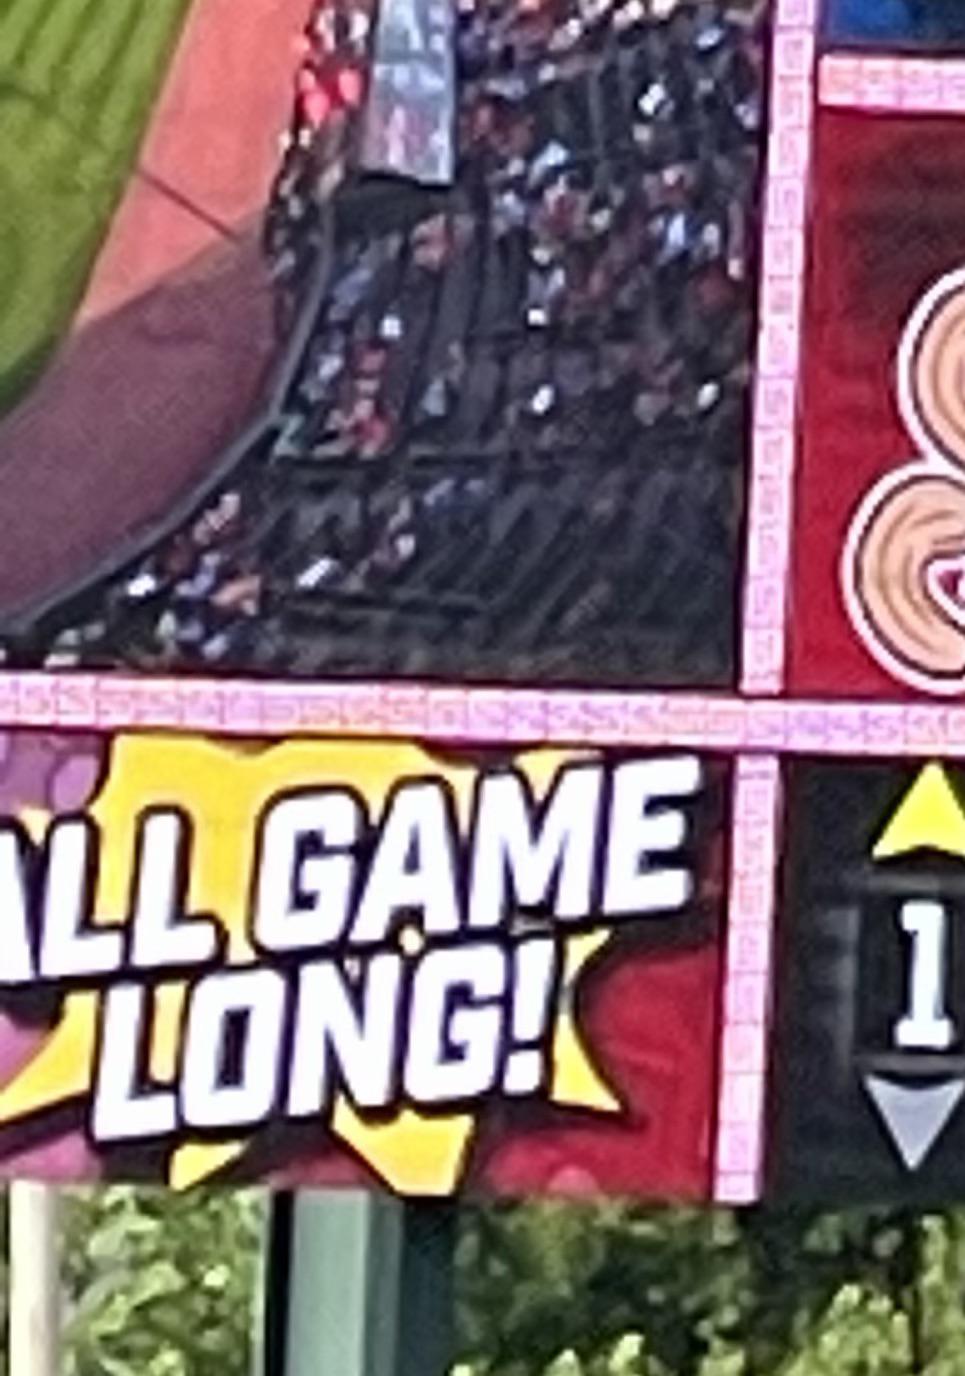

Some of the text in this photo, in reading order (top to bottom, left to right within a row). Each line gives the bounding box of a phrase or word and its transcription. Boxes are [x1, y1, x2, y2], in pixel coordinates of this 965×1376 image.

[258, 757, 700, 951] GAME
[94, 937, 556, 1143] LONG!
[894, 900, 953, 1050] 1
